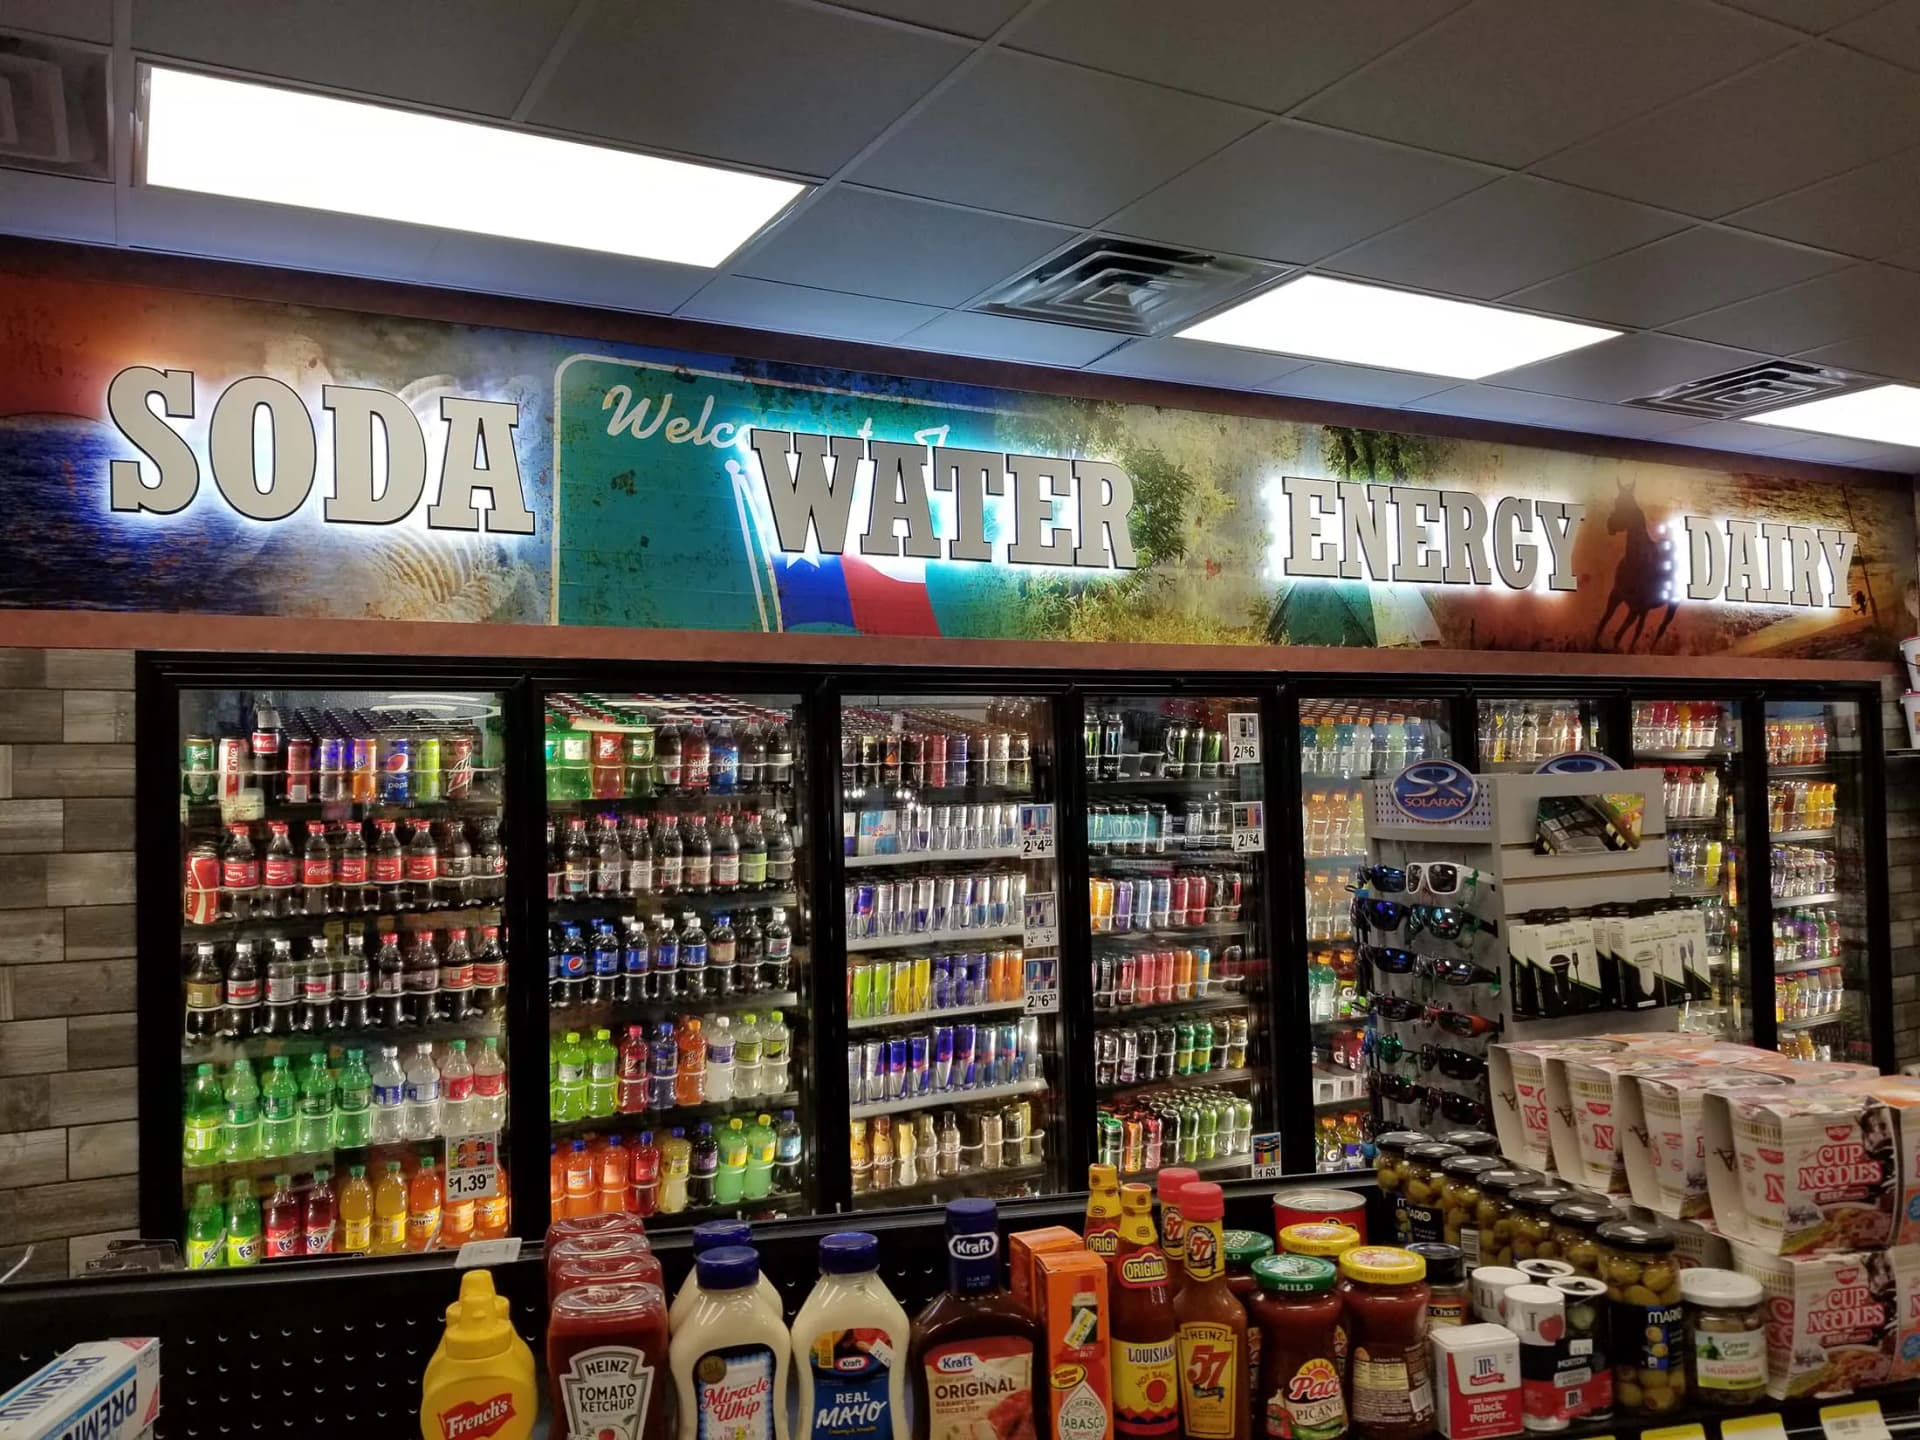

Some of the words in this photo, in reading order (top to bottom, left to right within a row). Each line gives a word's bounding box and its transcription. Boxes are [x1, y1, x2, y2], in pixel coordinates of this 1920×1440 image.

[108, 365, 535, 535] SODA
[750, 427, 1137, 570] WATER
[1282, 476, 1586, 592] ENERGY
[1684, 515, 1859, 608] DAIRY
[1404, 798, 1467, 808] SOLARAY
[1817, 1143, 1865, 1167] CUP
[449, 1173, 487, 1194] $1.39
[1800, 1162, 1884, 1190] NOODLES
[956, 1236, 991, 1254] Kraft
[1192, 1236, 1210, 1261] 57
[1278, 1283, 1314, 1292] MILD
[1827, 1287, 1869, 1310] CUP
[1807, 1305, 1885, 1335] NOODLES
[1190, 1330, 1225, 1341] HEINZ
[585, 1360, 630, 1377] HEINZ
[842, 1359, 863, 1368] Kraft
[943, 1355, 974, 1370] Kraft
[1187, 1344, 1232, 1388] 57
[577, 1383, 638, 1401] TOMATO
[702, 1376, 769, 1410] Miracle
[836, 1391, 871, 1404] REAL
[935, 1377, 1017, 1400] ORIGINAL
[580, 1399, 635, 1414] KETCHUP
[713, 1398, 761, 1422] Whip
[815, 1400, 888, 1429] MAYO
[1470, 1411, 1507, 1424] Pepper
[1473, 1401, 1503, 1414] Black
[446, 1399, 510, 1440] French's
[1060, 1415, 1105, 1430] TABASCO
